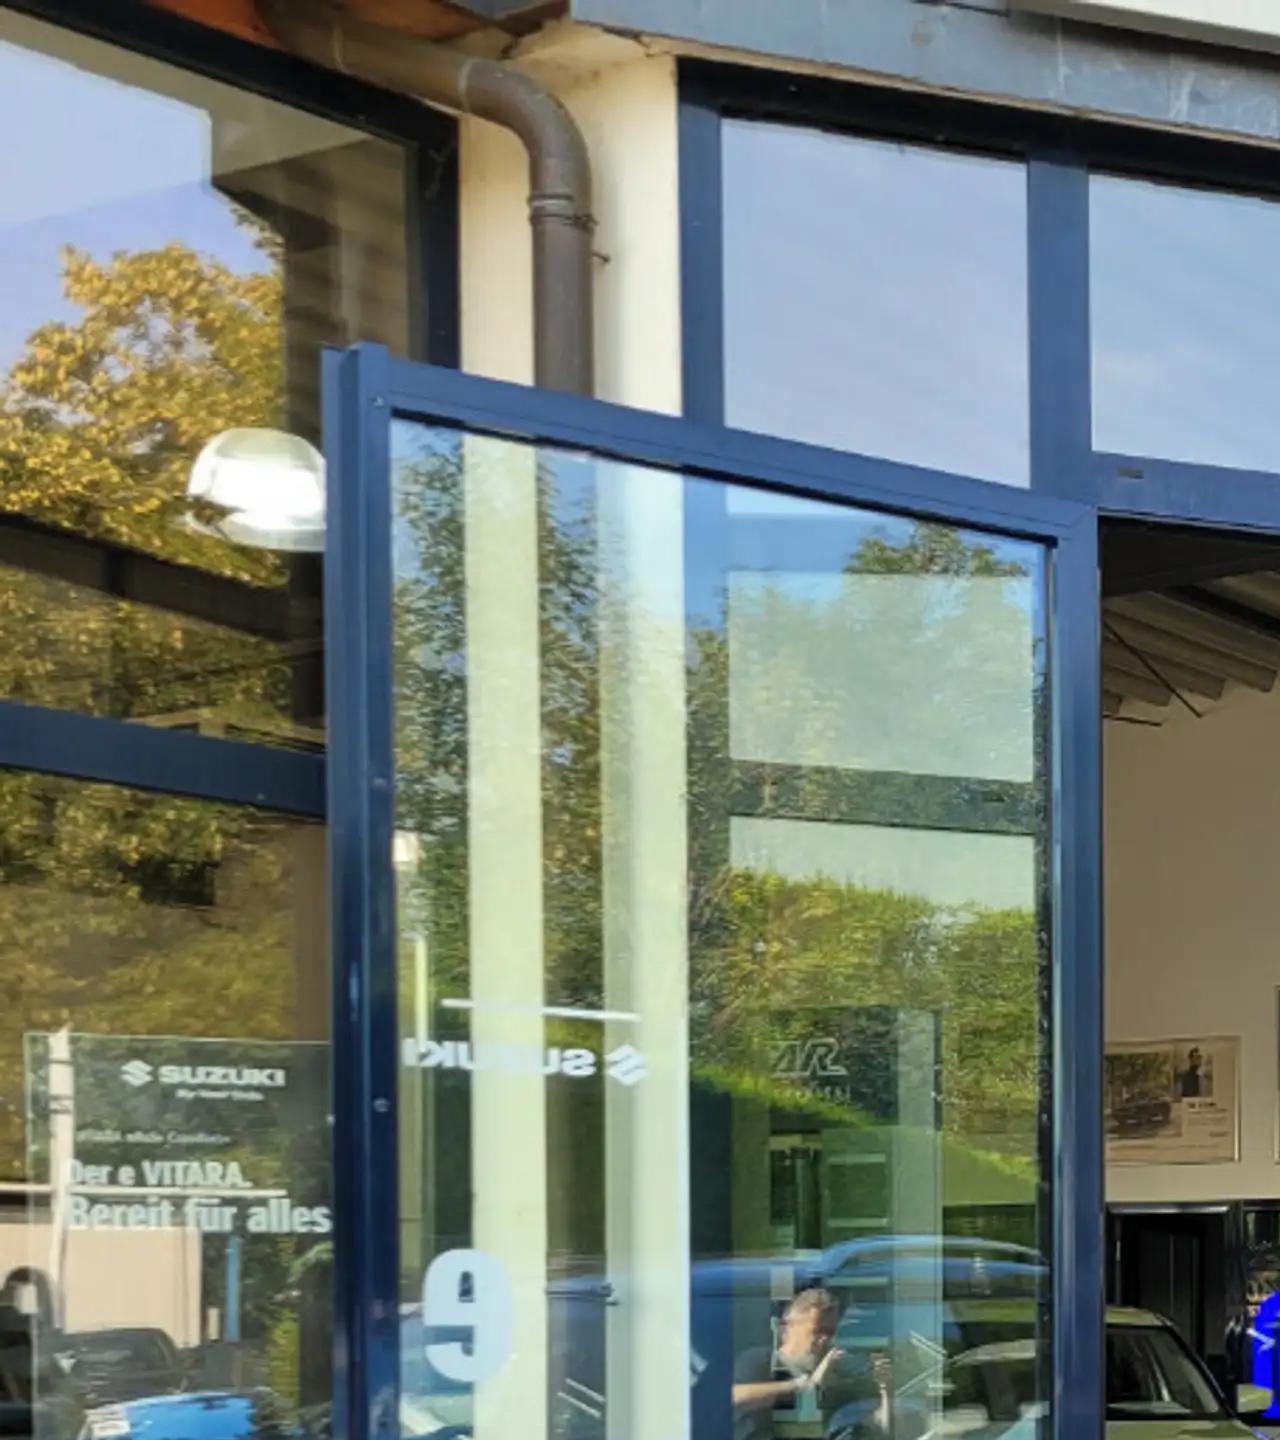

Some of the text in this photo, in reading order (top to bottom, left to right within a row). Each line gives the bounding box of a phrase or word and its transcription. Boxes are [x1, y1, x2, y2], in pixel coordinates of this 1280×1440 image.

[158, 1065, 286, 1087] SUZUKI
[70, 1159, 254, 1188] Der e VITARA.
[69, 1196, 333, 1233] Bereit für alles
